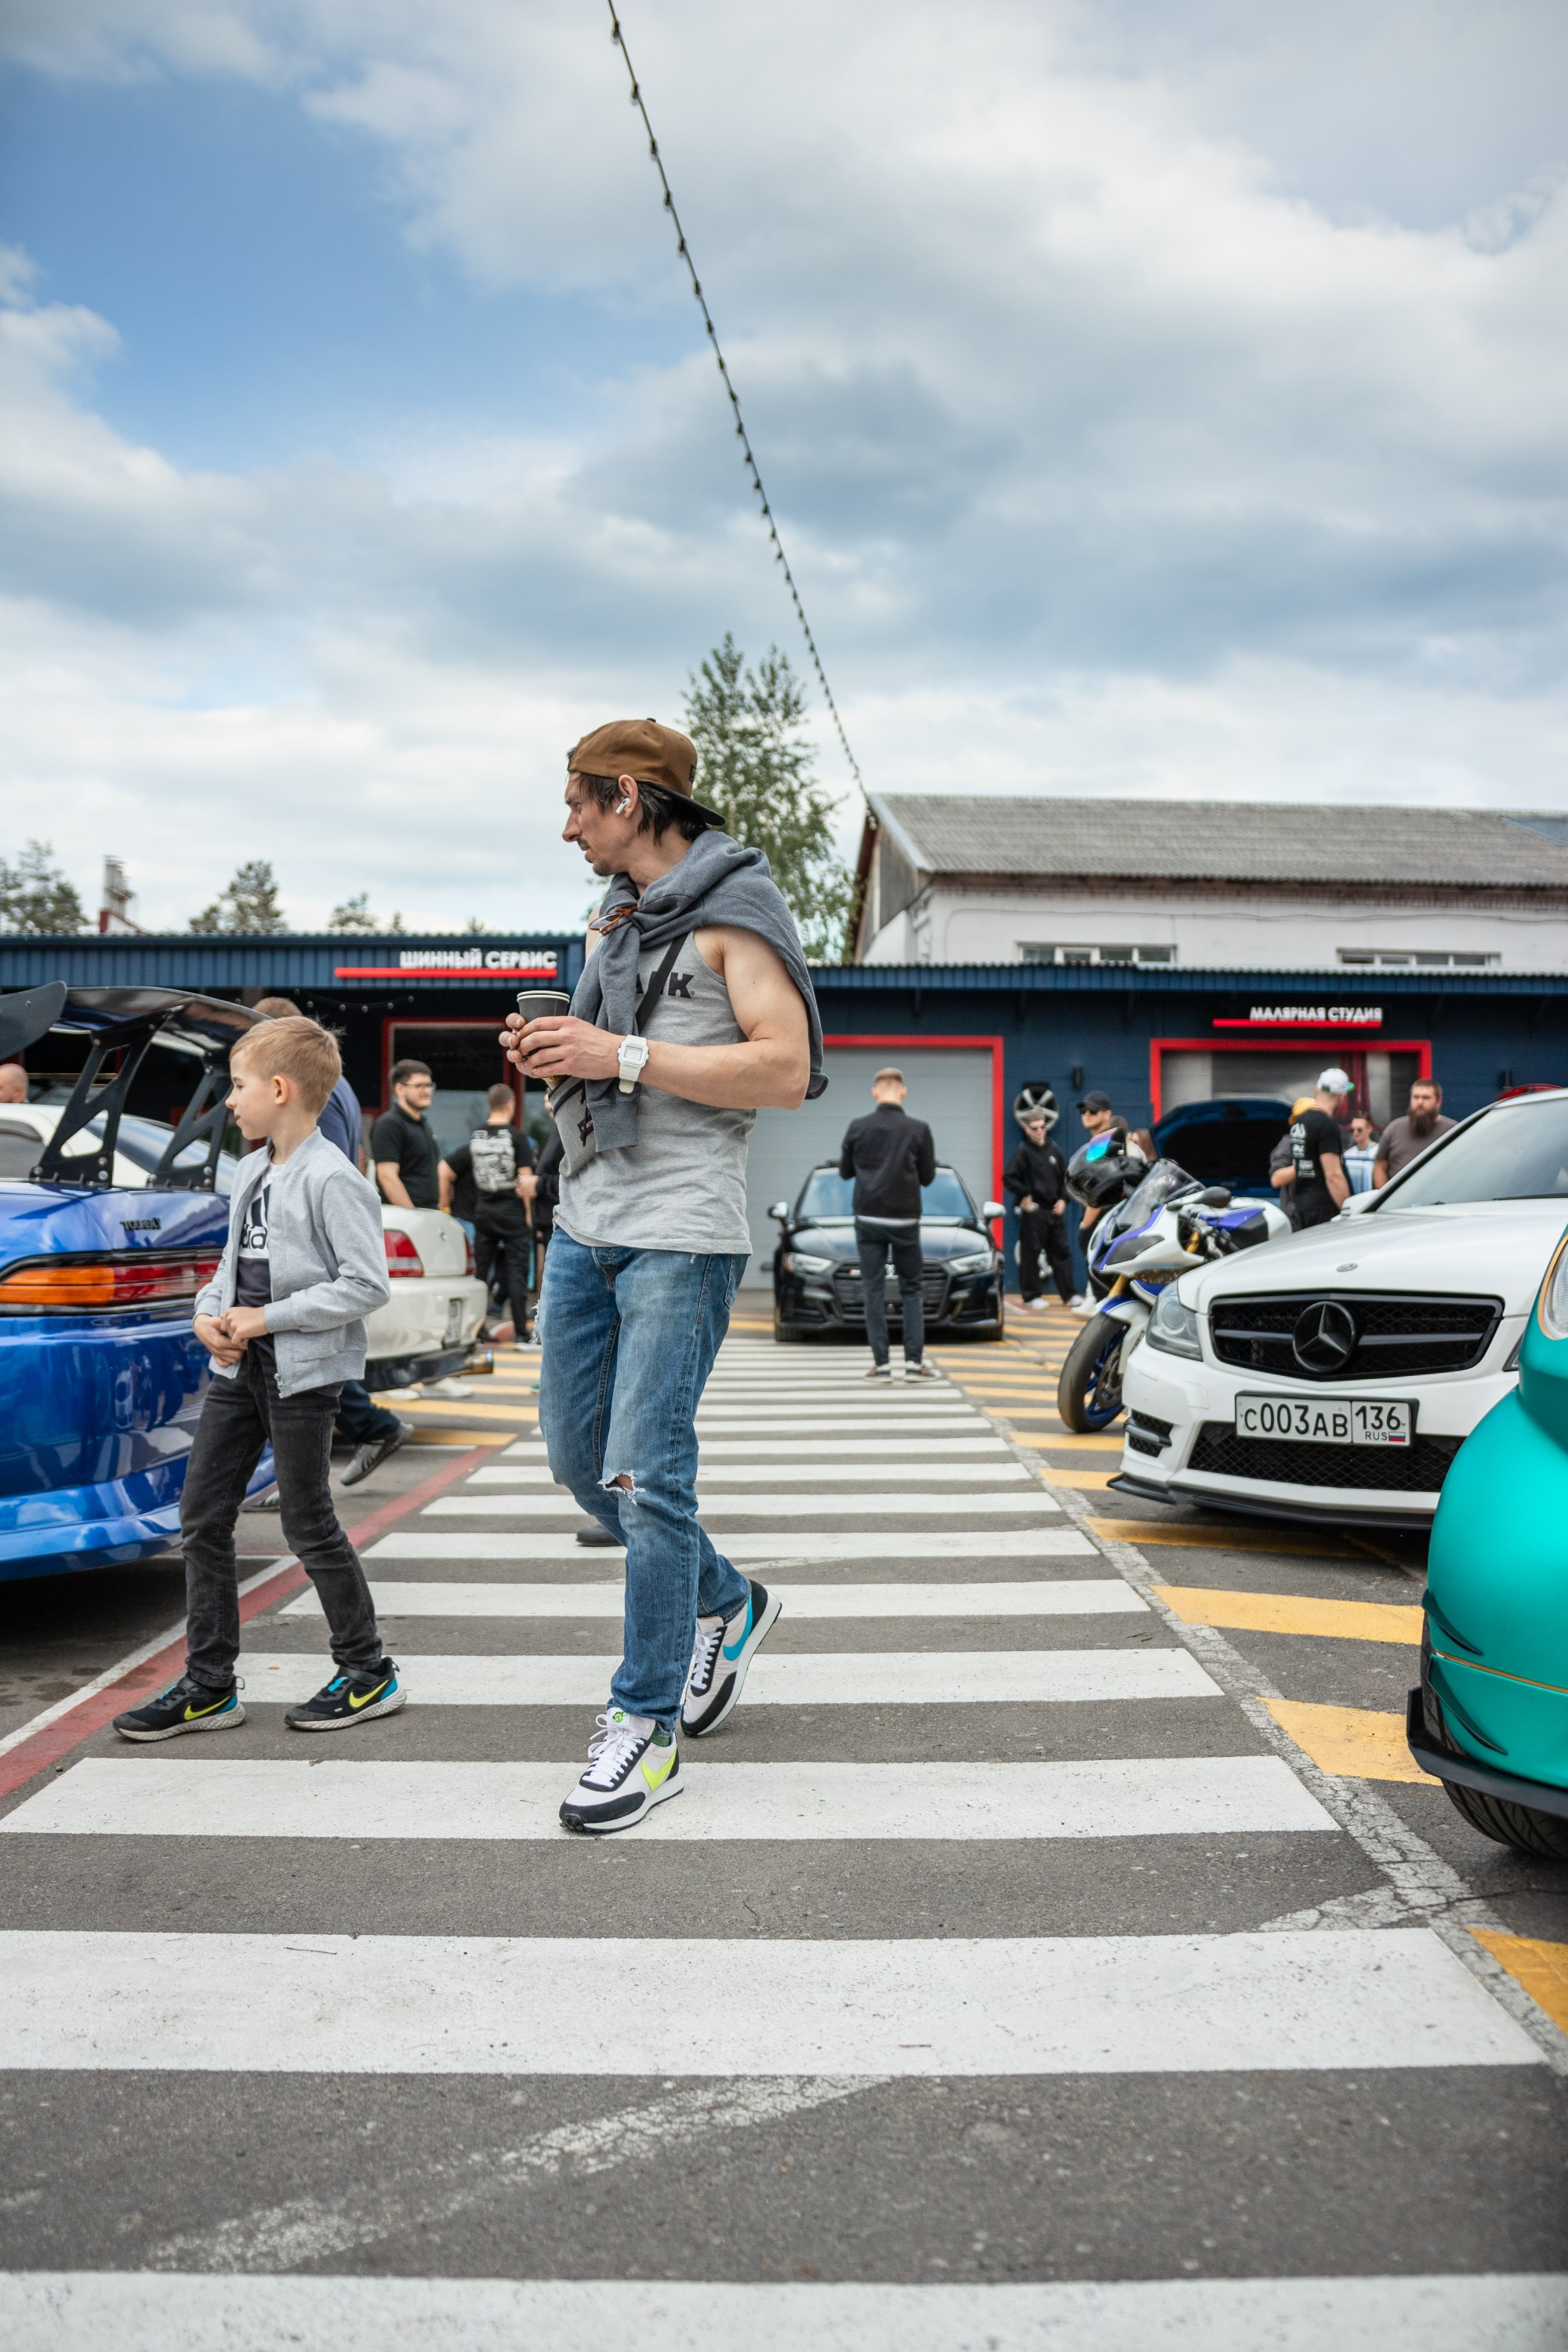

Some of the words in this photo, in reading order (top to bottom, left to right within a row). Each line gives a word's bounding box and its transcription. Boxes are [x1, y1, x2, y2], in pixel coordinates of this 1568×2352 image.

[400, 948, 482, 969] ШИННЫЙ
[485, 951, 557, 969] СЕРВИС
[1250, 1007, 1326, 1021] МАЛЯРНАЯ
[1327, 1007, 1383, 1023] СТУДИЯ
[1355, 1405, 1401, 1431] 136
[1365, 1432, 1388, 1441] RUS
